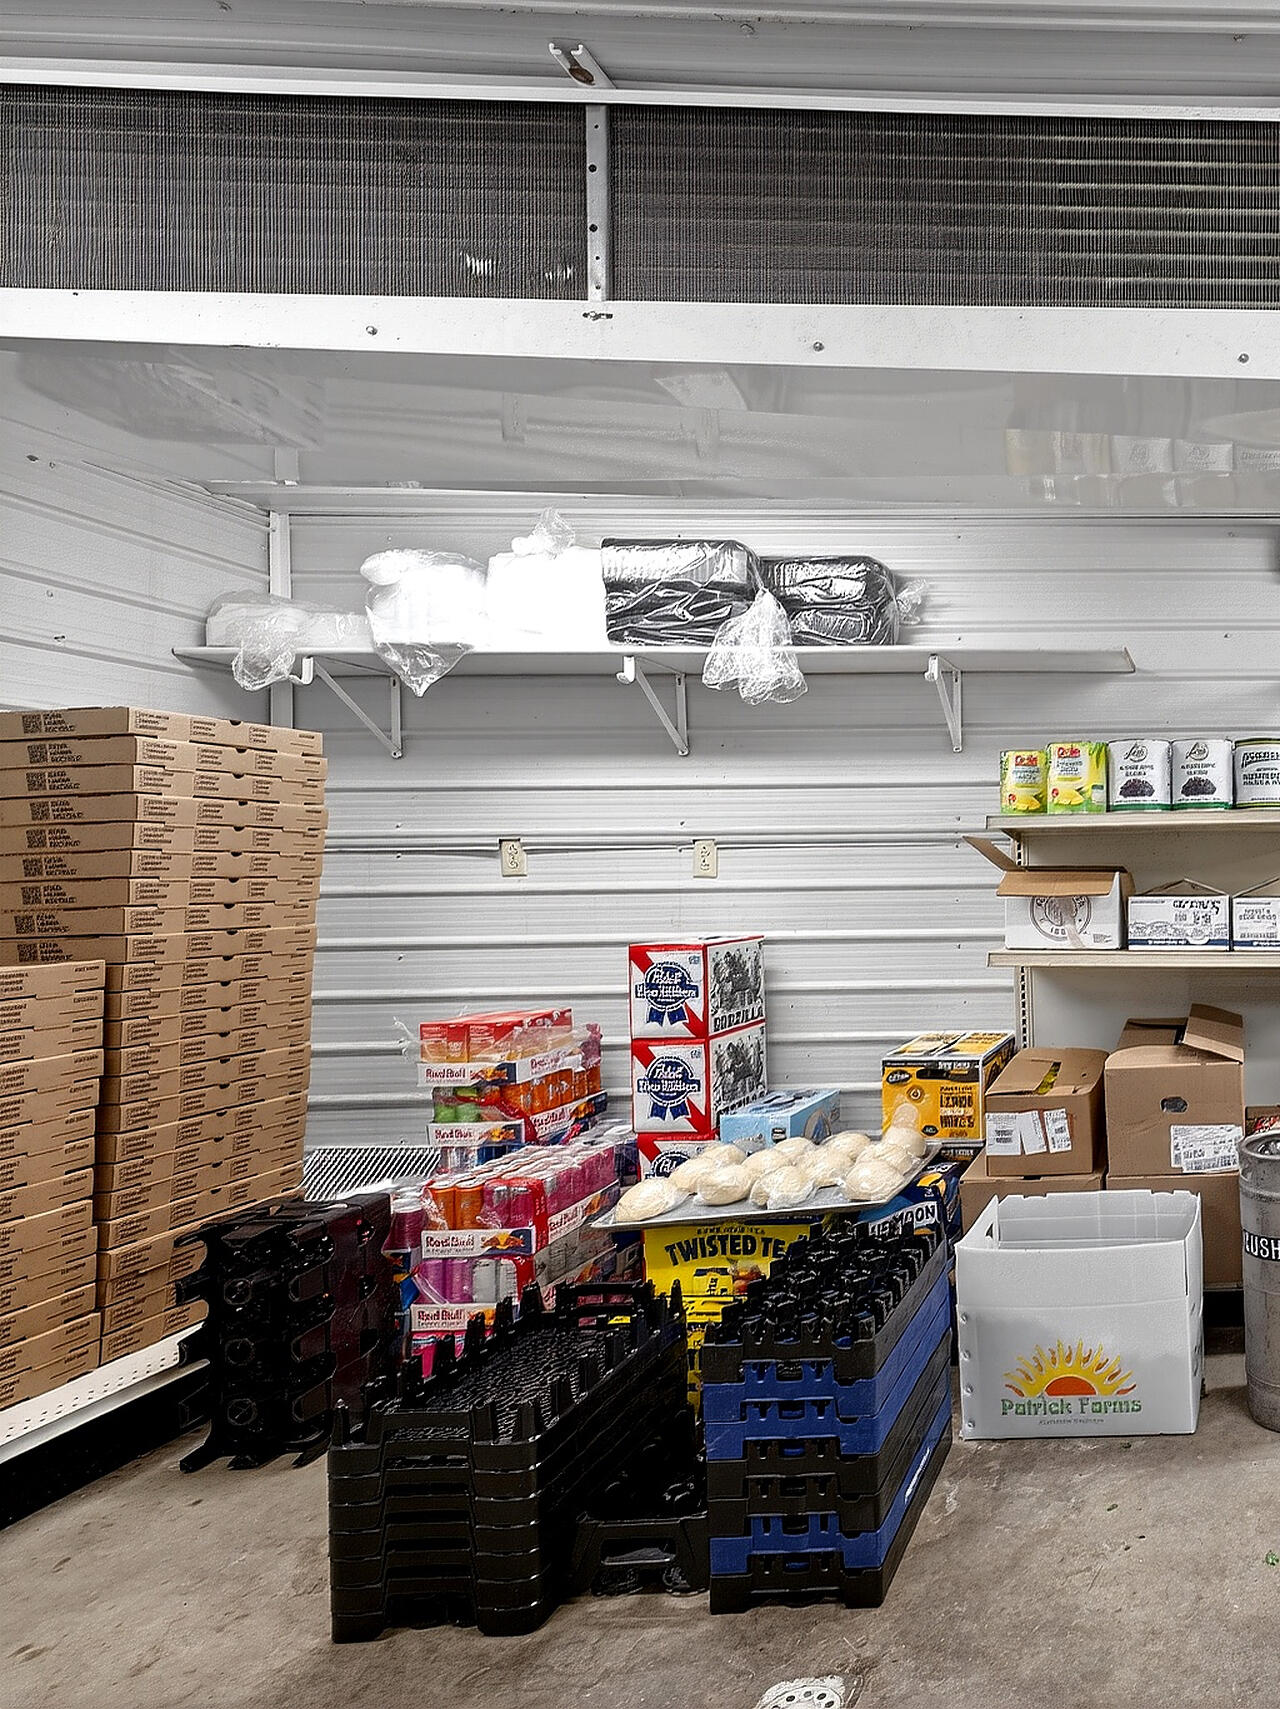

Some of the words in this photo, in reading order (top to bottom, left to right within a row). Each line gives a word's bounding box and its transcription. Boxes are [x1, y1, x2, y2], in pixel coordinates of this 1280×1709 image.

[664, 1234, 757, 1266] TWISTED
[761, 1236, 787, 1258] TE
[1001, 1396, 1072, 1416] Patrick
[1078, 1397, 1142, 1415] Farms
